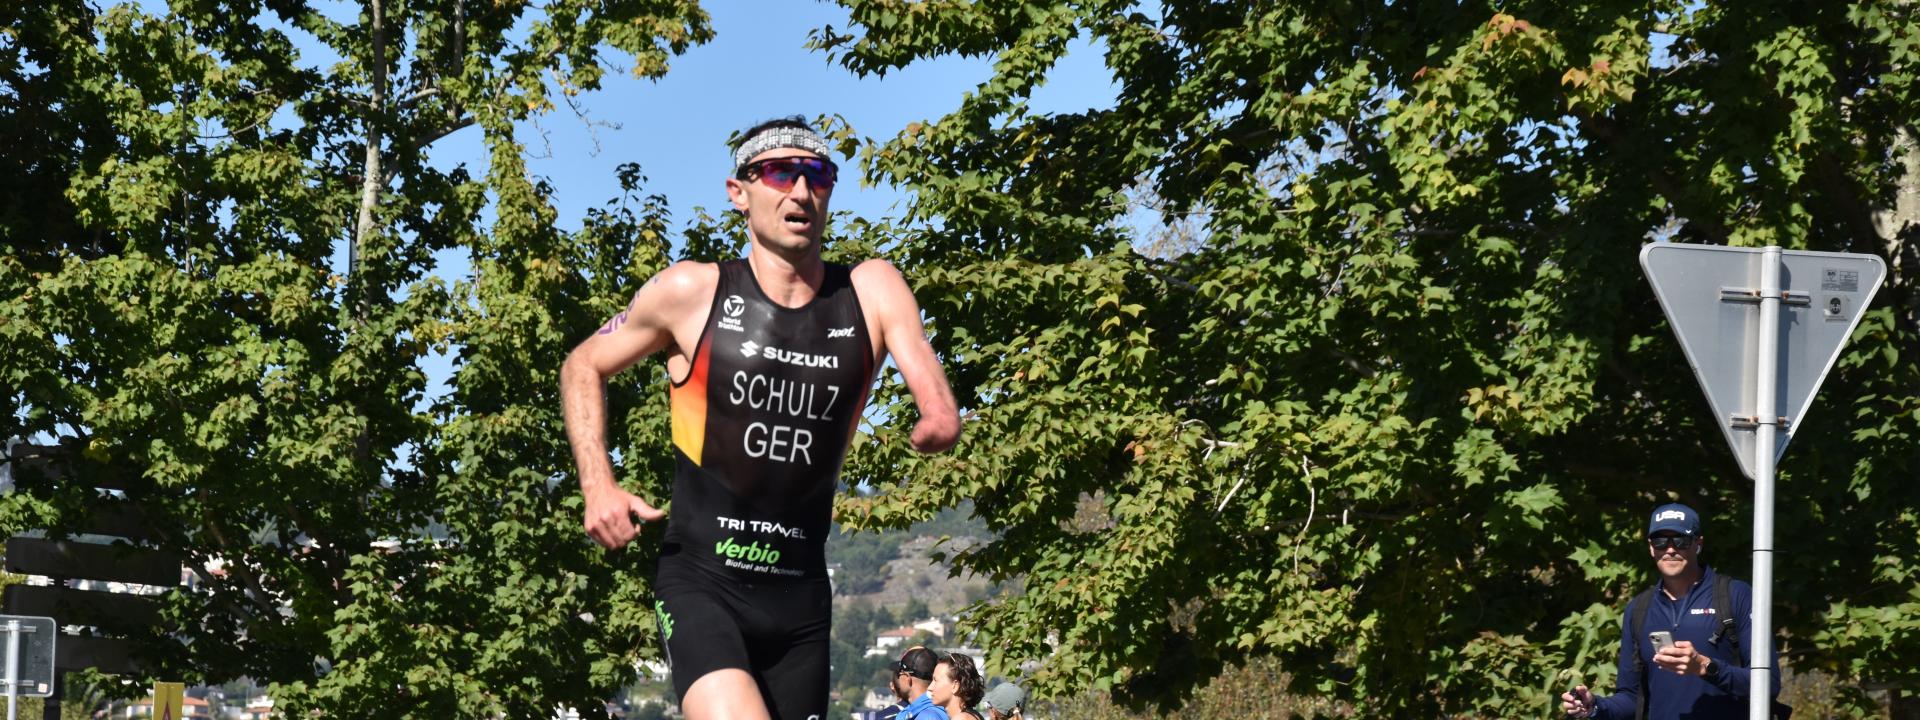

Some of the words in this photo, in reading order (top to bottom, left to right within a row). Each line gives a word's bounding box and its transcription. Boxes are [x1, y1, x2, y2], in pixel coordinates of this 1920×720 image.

[763, 346, 839, 369] SUZUKI
[729, 370, 840, 421] SCHULZ
[743, 421, 813, 465] GER
[717, 516, 745, 531] TRI
[749, 520, 807, 539] TRAVEL
[1655, 510, 1686, 522] USA
[725, 558, 753, 571] Biofuel
[753, 565, 769, 573] and
